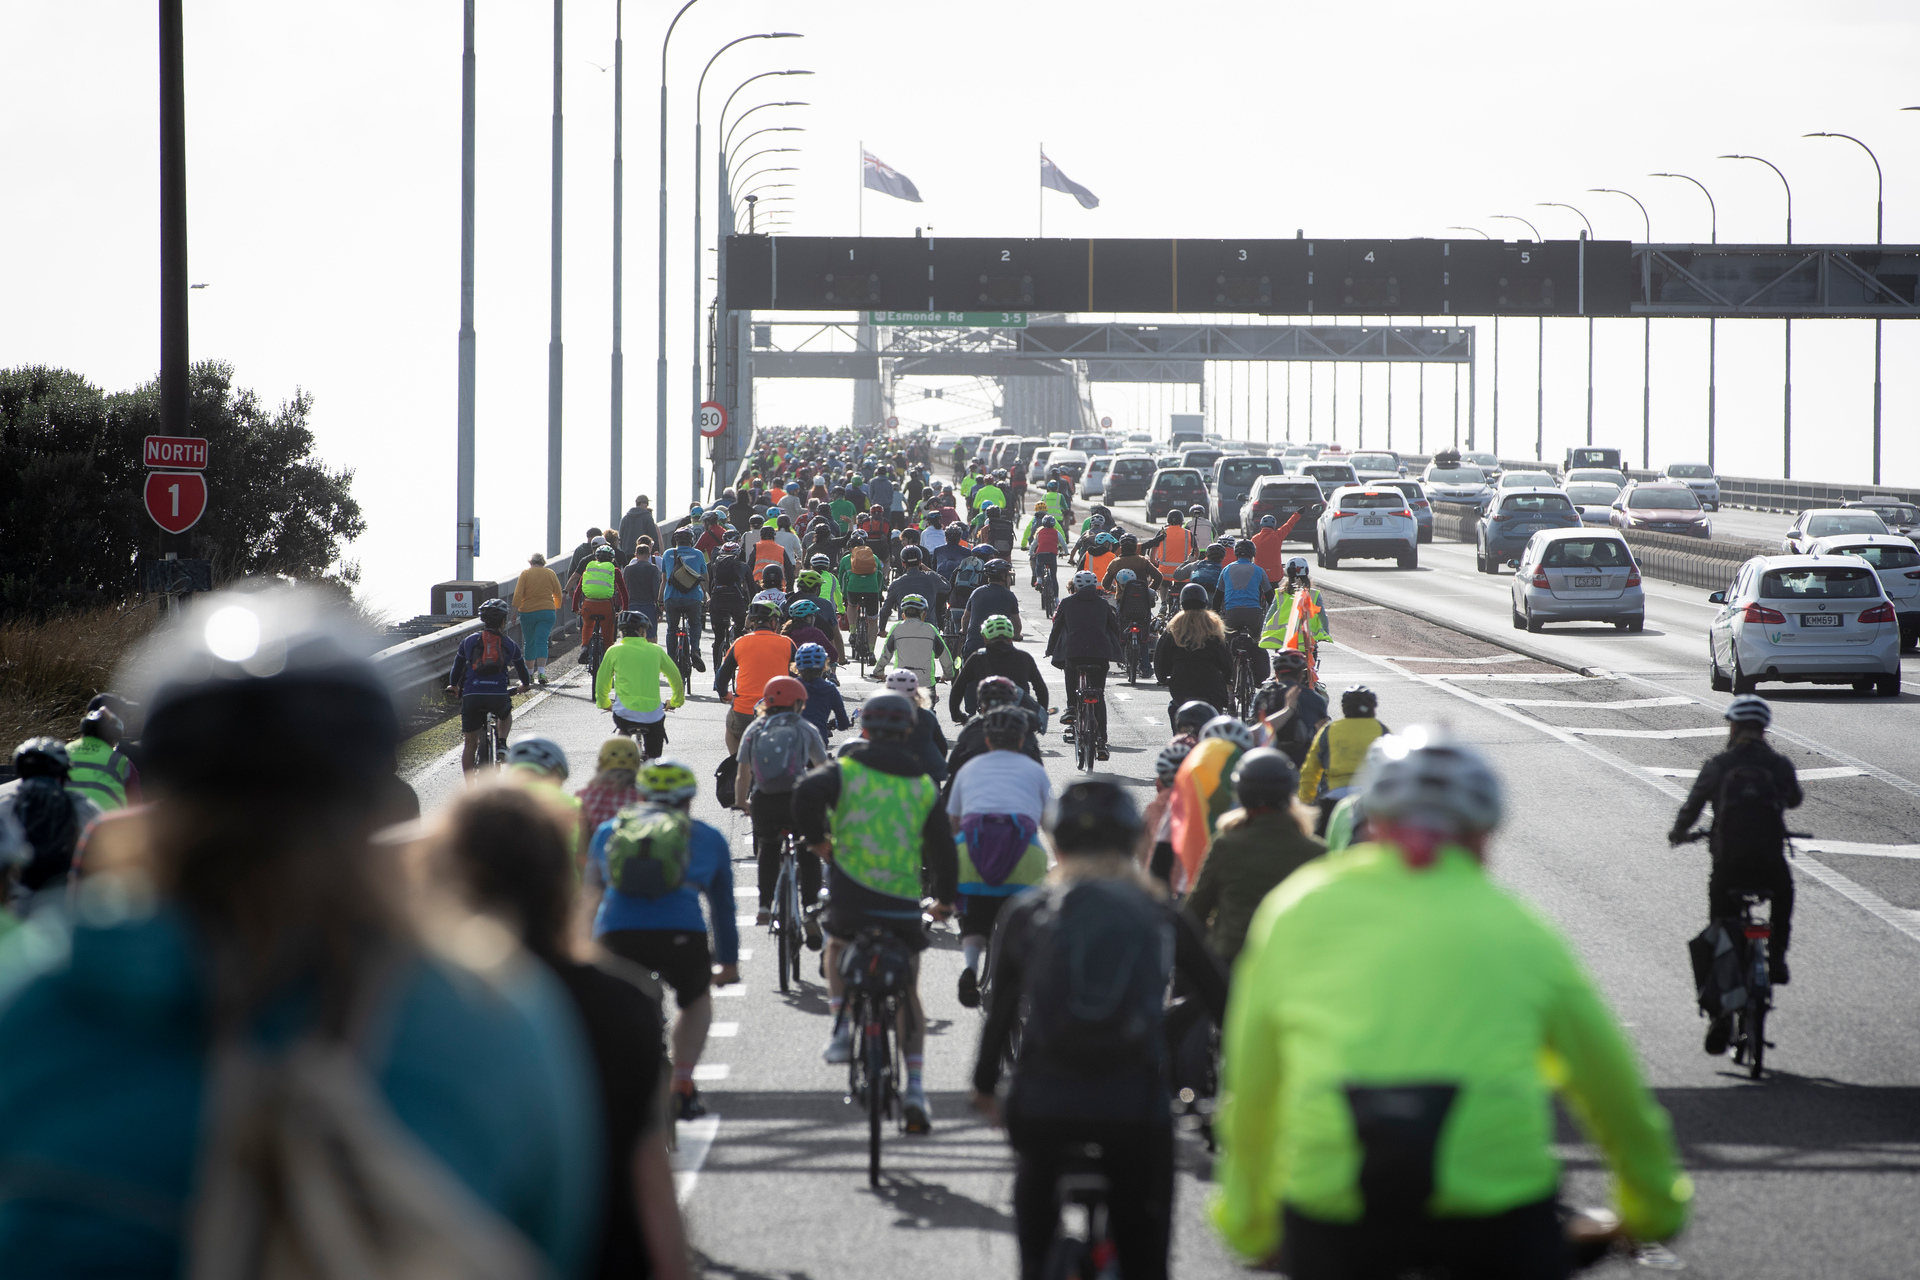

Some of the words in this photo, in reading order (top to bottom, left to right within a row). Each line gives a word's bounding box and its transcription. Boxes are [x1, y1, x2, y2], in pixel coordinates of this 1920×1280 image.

[849, 249, 854, 261] 1
[1000, 249, 1011, 261] 2
[1238, 249, 1248, 261] 3
[1364, 251, 1375, 263] 4
[1521, 251, 1531, 264] 5
[888, 311, 942, 321] Esmonde
[948, 312, 964, 322] Rd
[701, 412, 720, 427] 80
[148, 441, 204, 463] NORTH
[168, 483, 180, 517] 1
